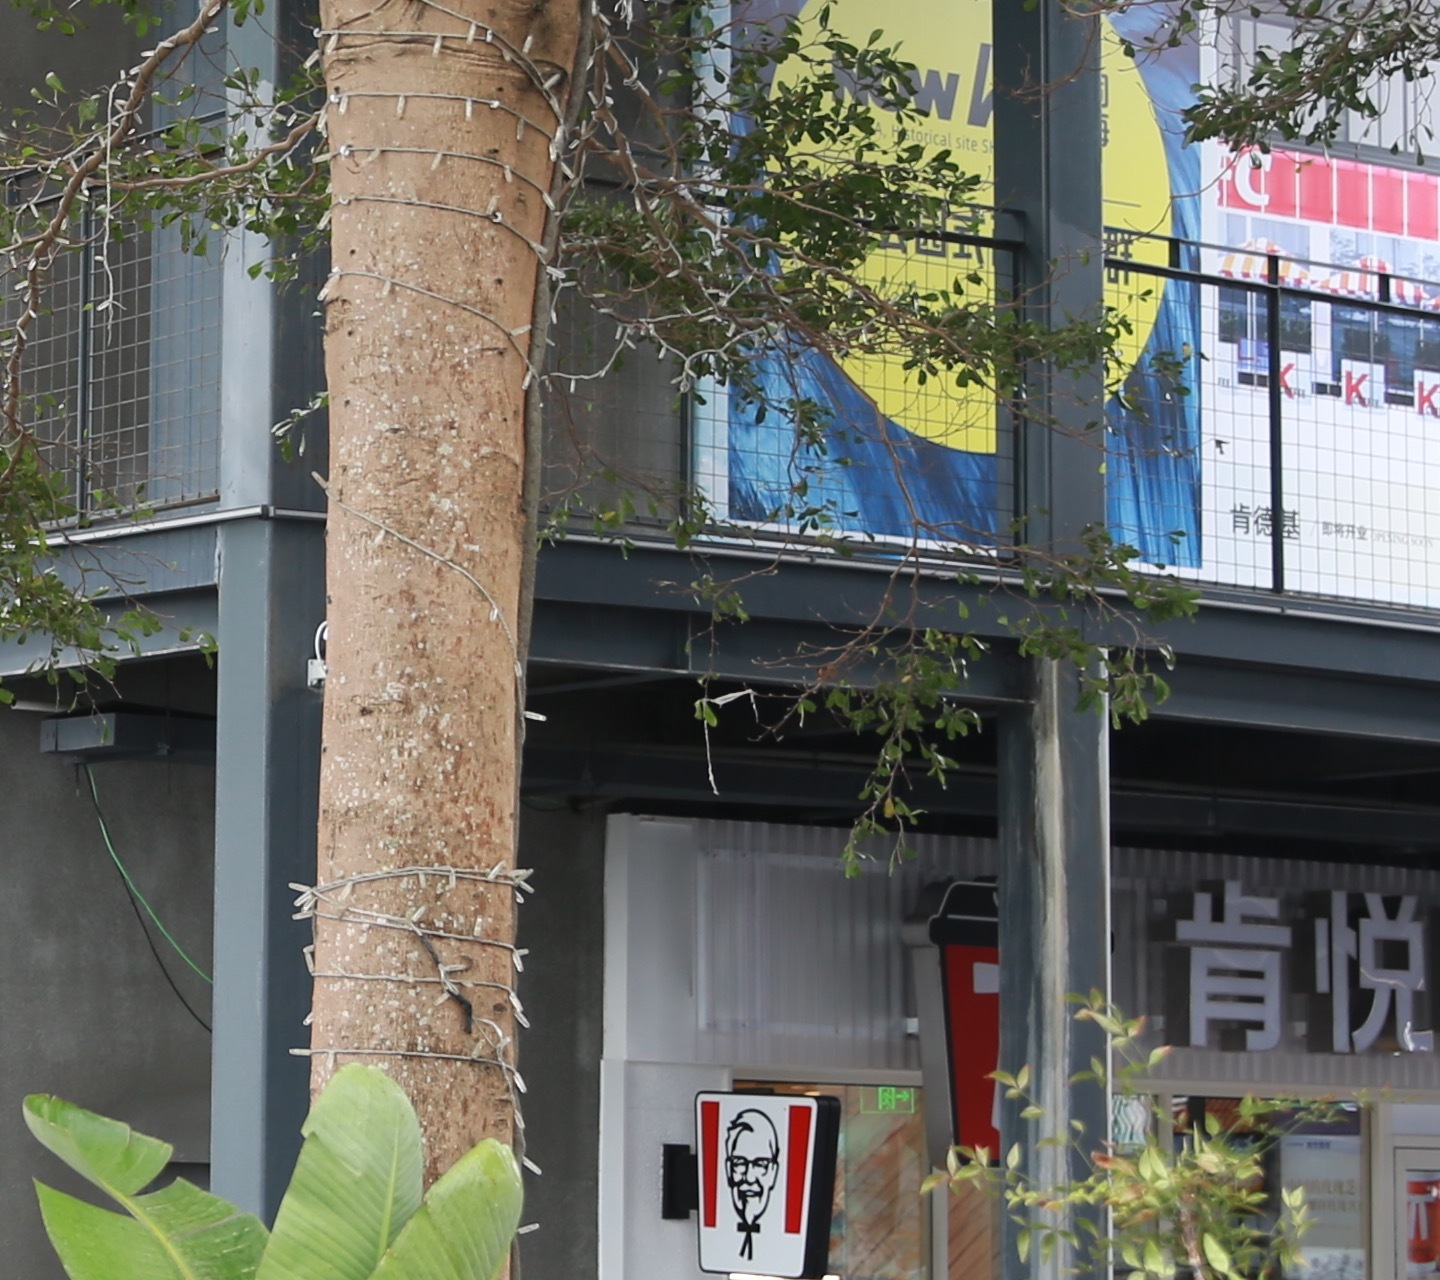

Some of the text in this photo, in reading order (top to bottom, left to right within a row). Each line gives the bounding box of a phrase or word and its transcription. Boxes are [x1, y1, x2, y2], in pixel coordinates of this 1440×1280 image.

[891, 123, 952, 148] Hstorical
[955, 133, 980, 153] site
[1344, 370, 1369, 408] K
